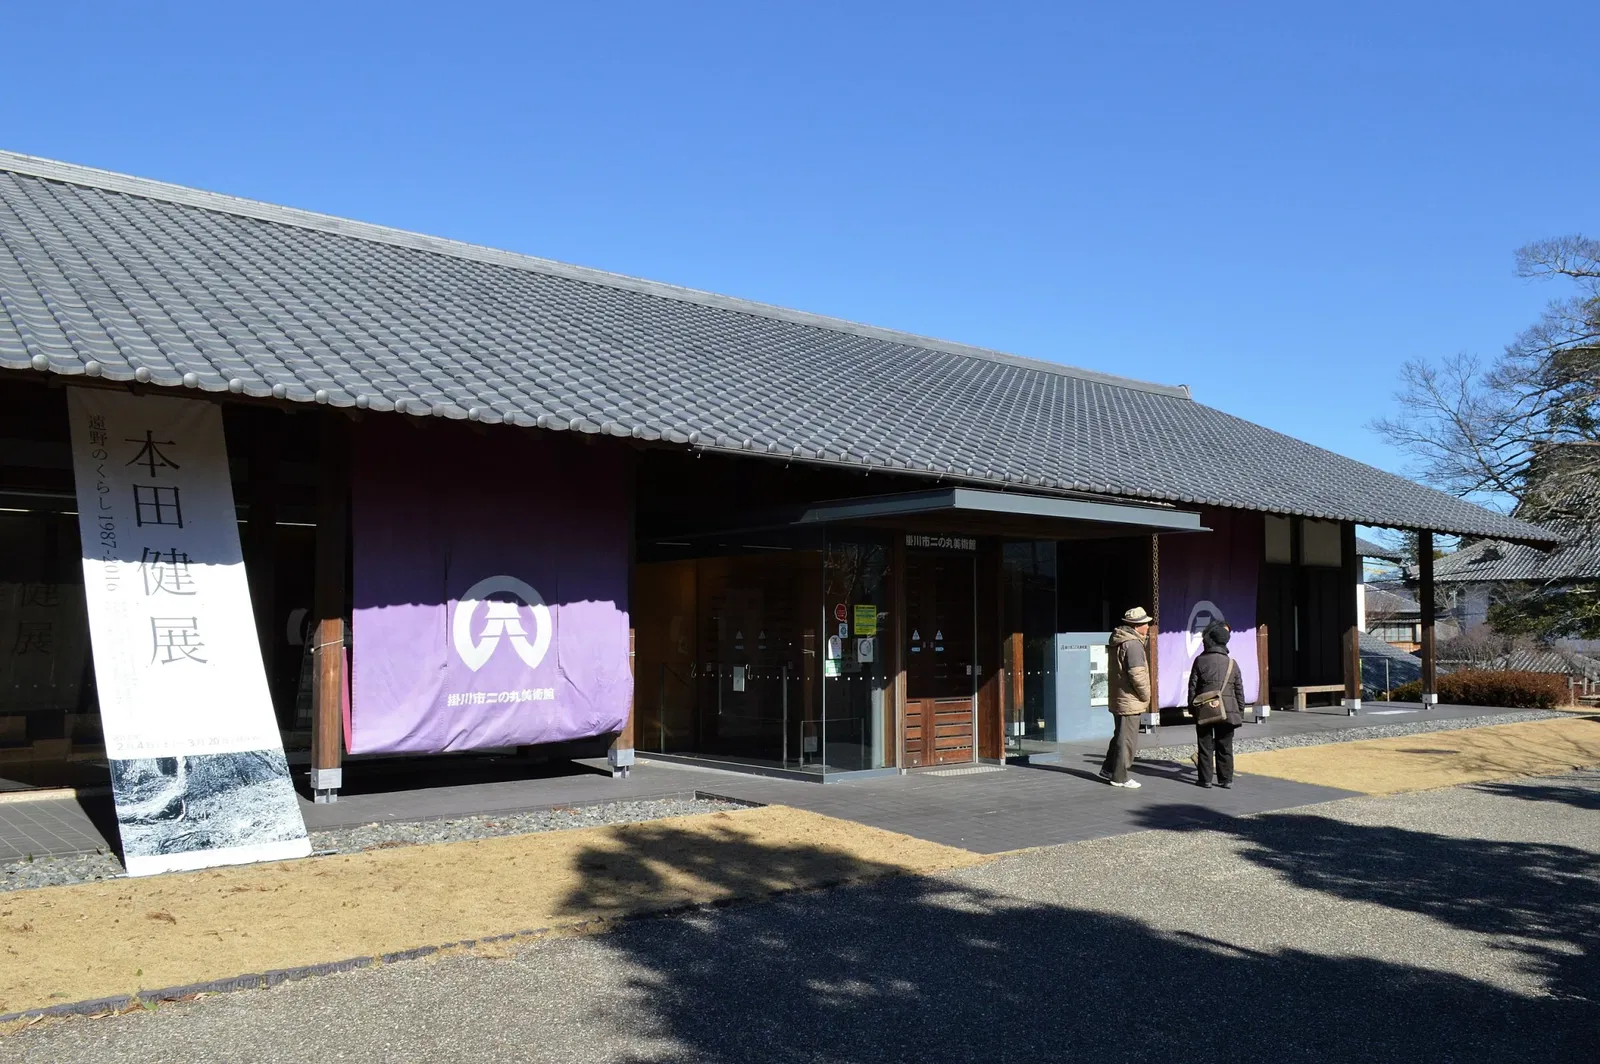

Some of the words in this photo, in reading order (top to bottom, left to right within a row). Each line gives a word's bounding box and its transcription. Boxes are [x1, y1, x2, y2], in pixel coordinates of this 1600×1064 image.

[125, 430, 208, 666] 本田健展
[447, 688, 555, 707] 掛川市二の丸美術館
